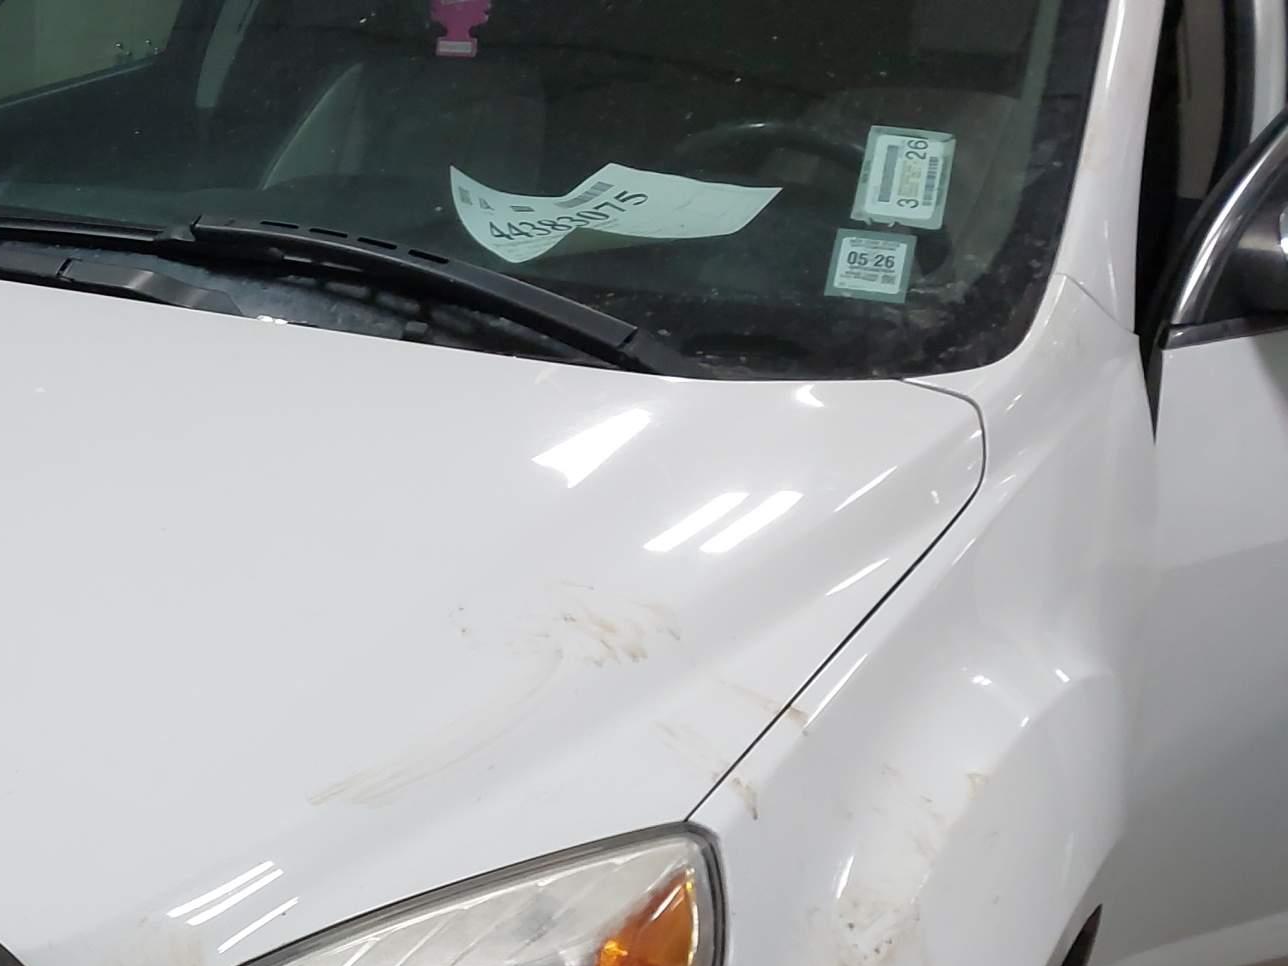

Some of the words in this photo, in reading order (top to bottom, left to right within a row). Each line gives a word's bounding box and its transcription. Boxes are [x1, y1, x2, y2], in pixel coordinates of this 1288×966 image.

[905, 140, 929, 160] 26
[896, 198, 919, 209] 3
[489, 190, 649, 241] 44383075
[847, 250, 868, 266] 05
[873, 254, 895, 269] 26
